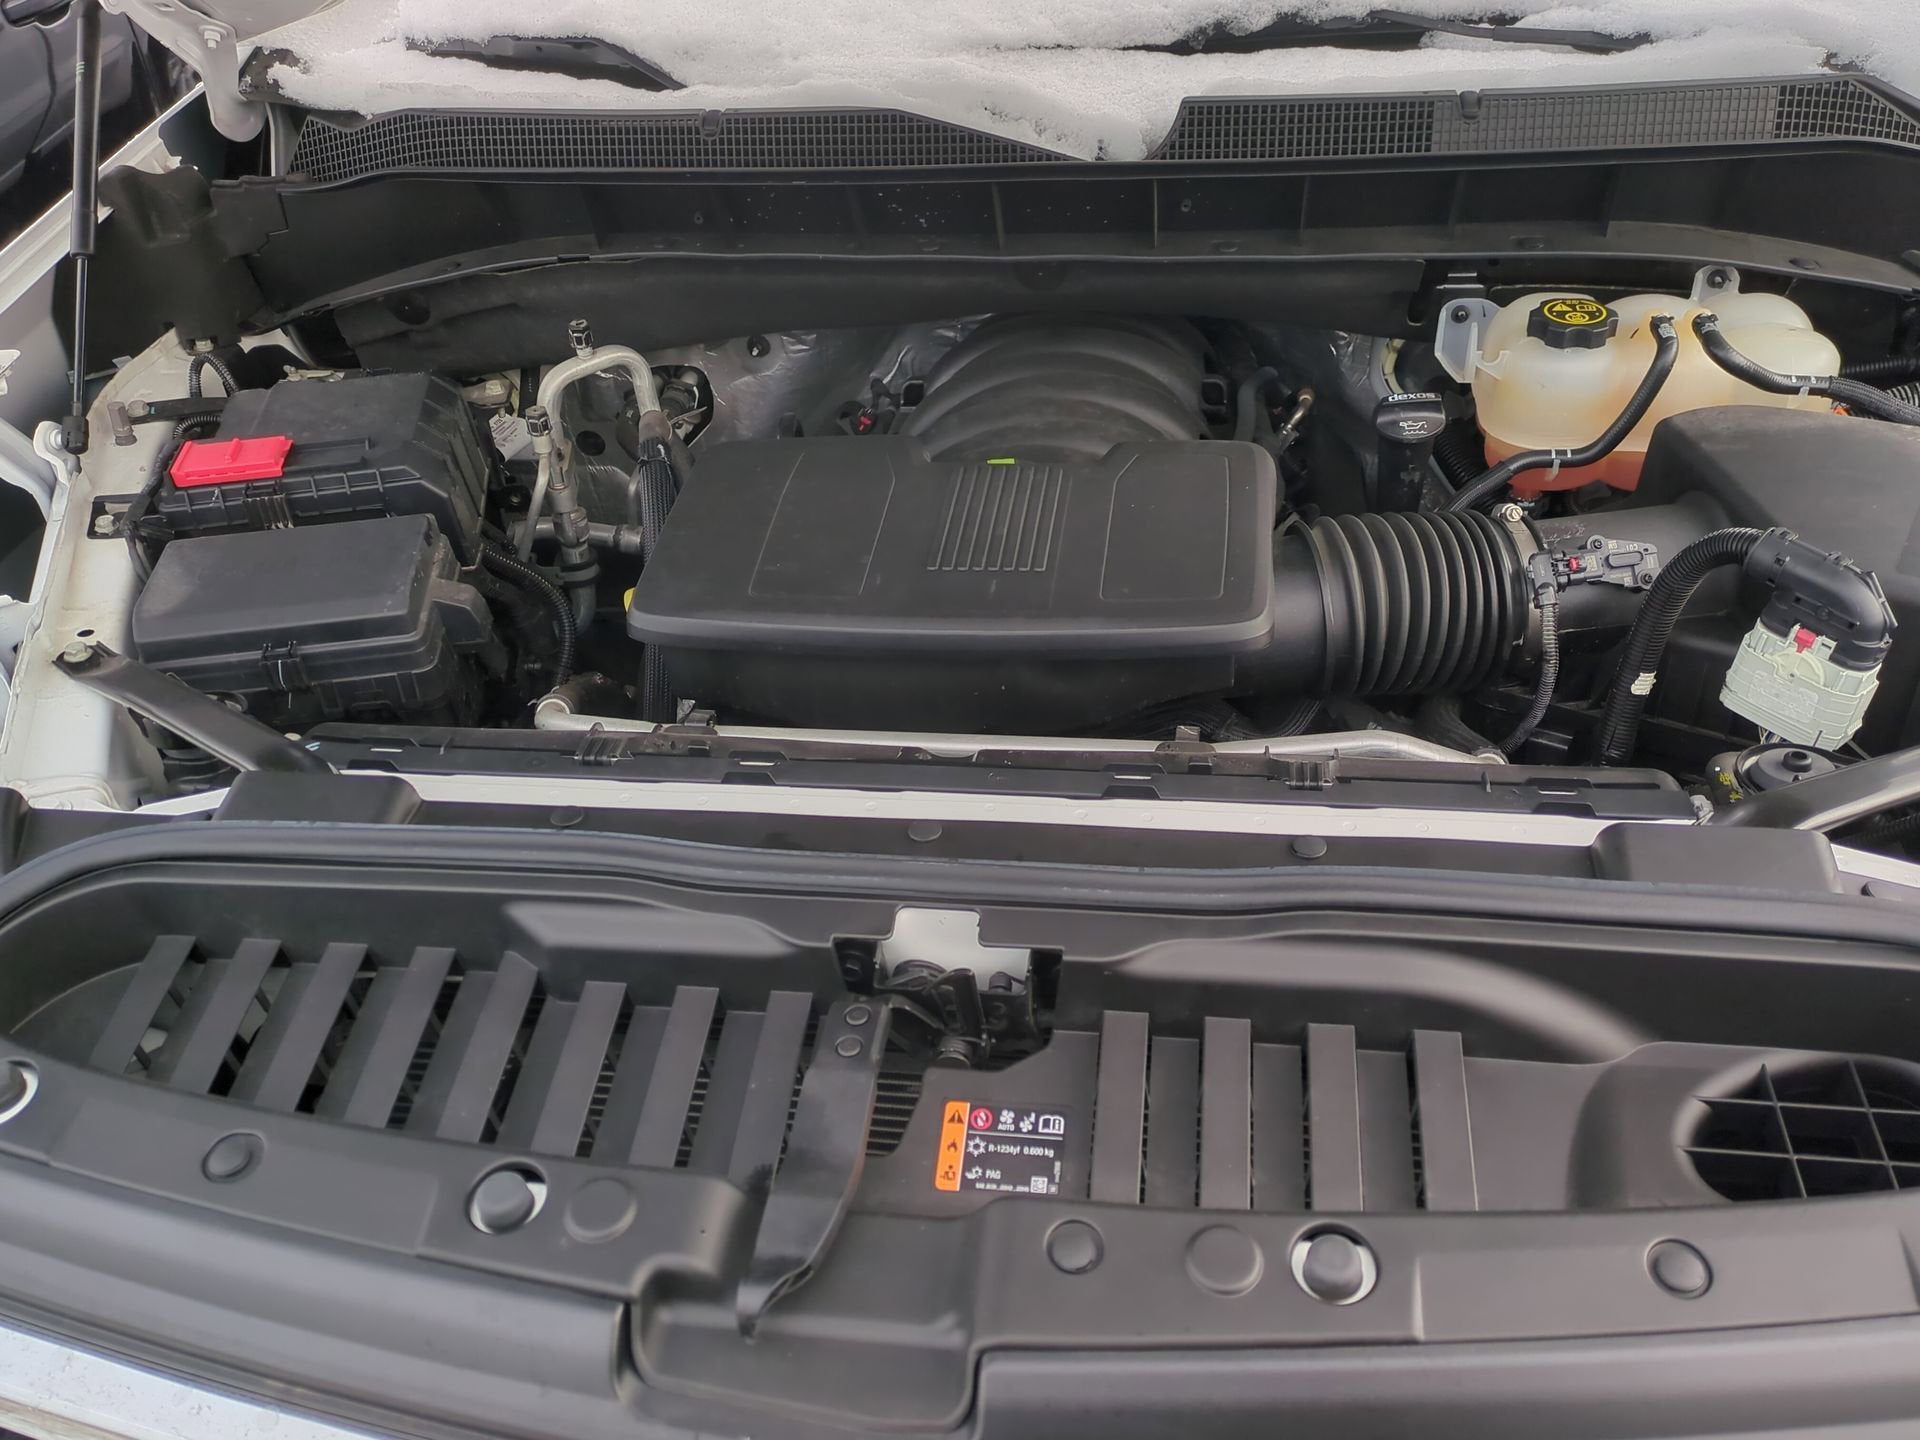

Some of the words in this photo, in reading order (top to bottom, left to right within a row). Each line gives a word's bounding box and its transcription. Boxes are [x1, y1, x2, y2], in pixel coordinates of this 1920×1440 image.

[1388, 393, 1436, 401] dexos
[997, 1123, 1015, 1131] AUTO
[988, 1143, 1020, 1155] R-1234yf
[1044, 1146, 1054, 1158] kg
[985, 1169, 1001, 1179] PAG
